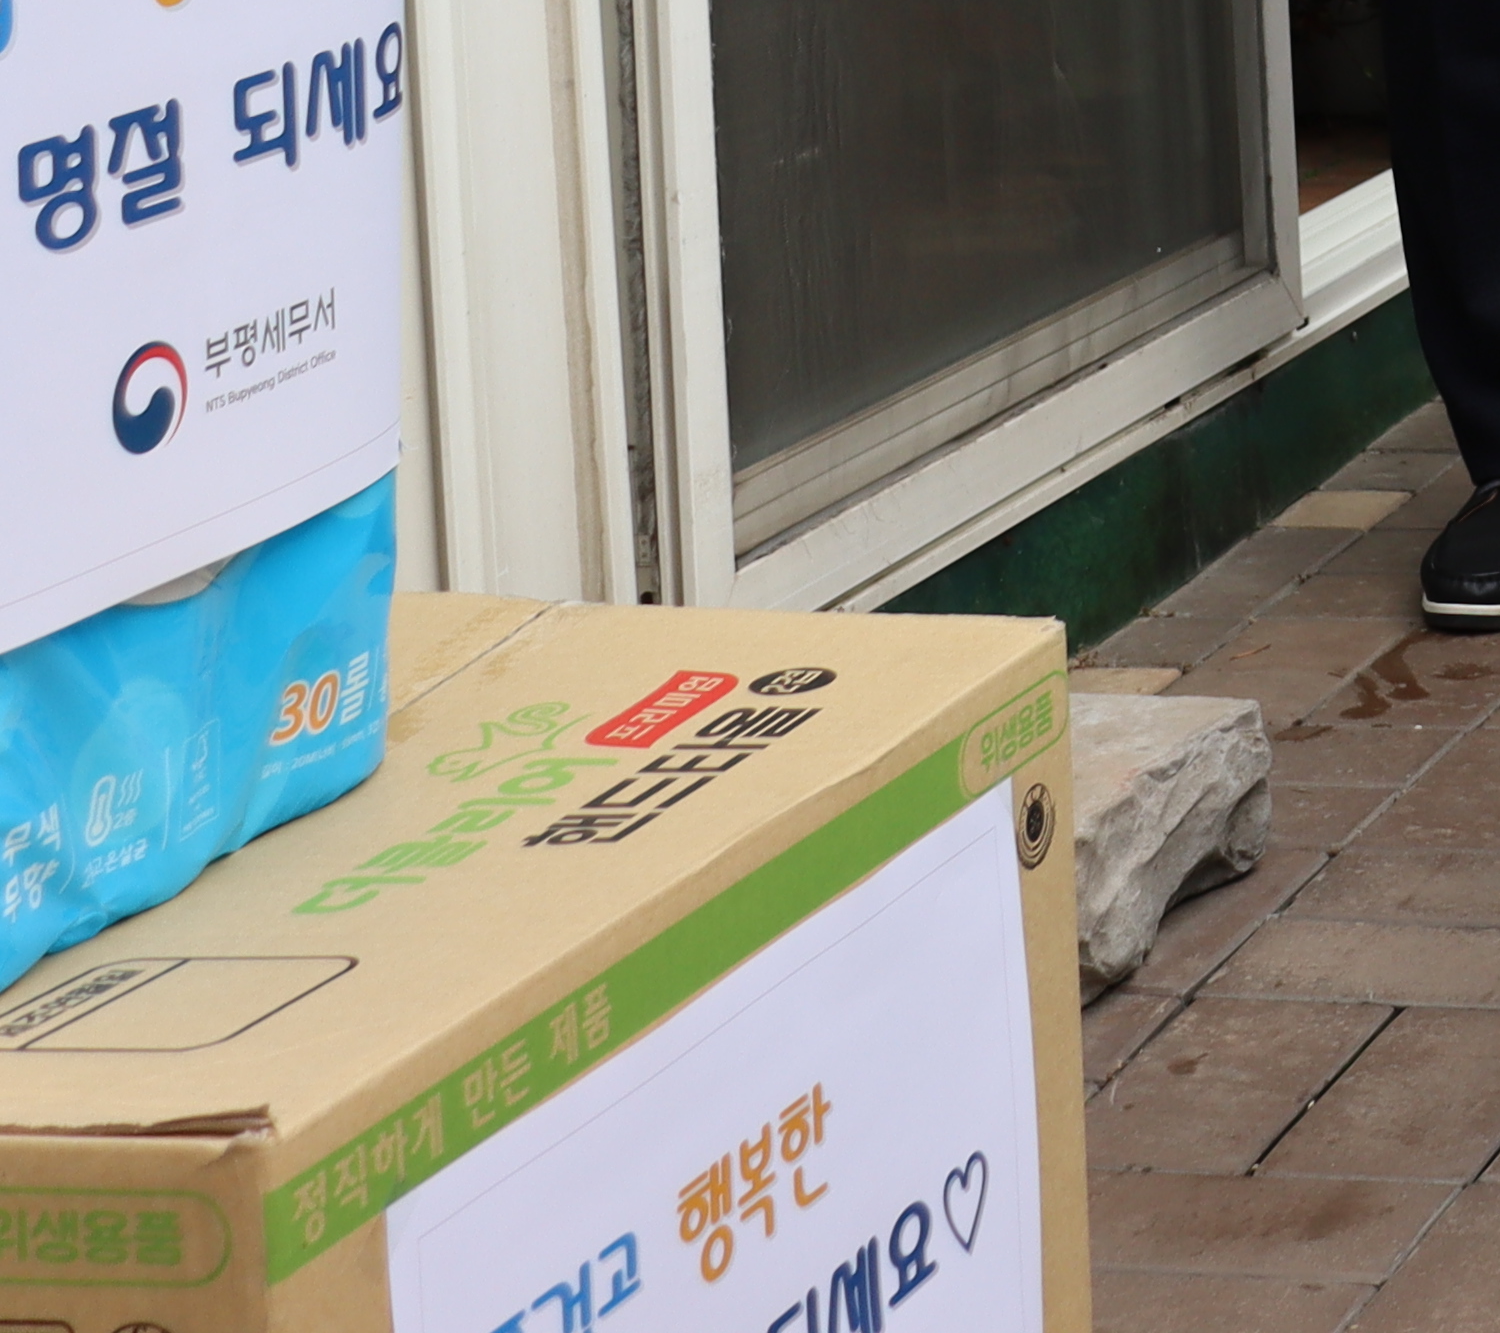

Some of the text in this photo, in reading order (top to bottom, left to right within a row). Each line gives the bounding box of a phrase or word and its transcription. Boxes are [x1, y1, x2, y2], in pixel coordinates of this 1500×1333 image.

[17, 99, 184, 253] 명절
[205, 287, 336, 379] 부평세무서
[206, 350, 337, 413] NTS Bupyeong District Office
[268, 651, 370, 747] 30롤
[603, 675, 725, 742] 프리미엄
[981, 690, 1053, 774] 위생용품
[521, 706, 823, 848] 핸드타올
[2, 801, 63, 866] 무색
[291, 757, 620, 914] 더클리어
[2, 859, 60, 923] 무향
[293, 982, 613, 1245] 정직하게 만든 제품
[676, 1082, 832, 1284] 행복한
